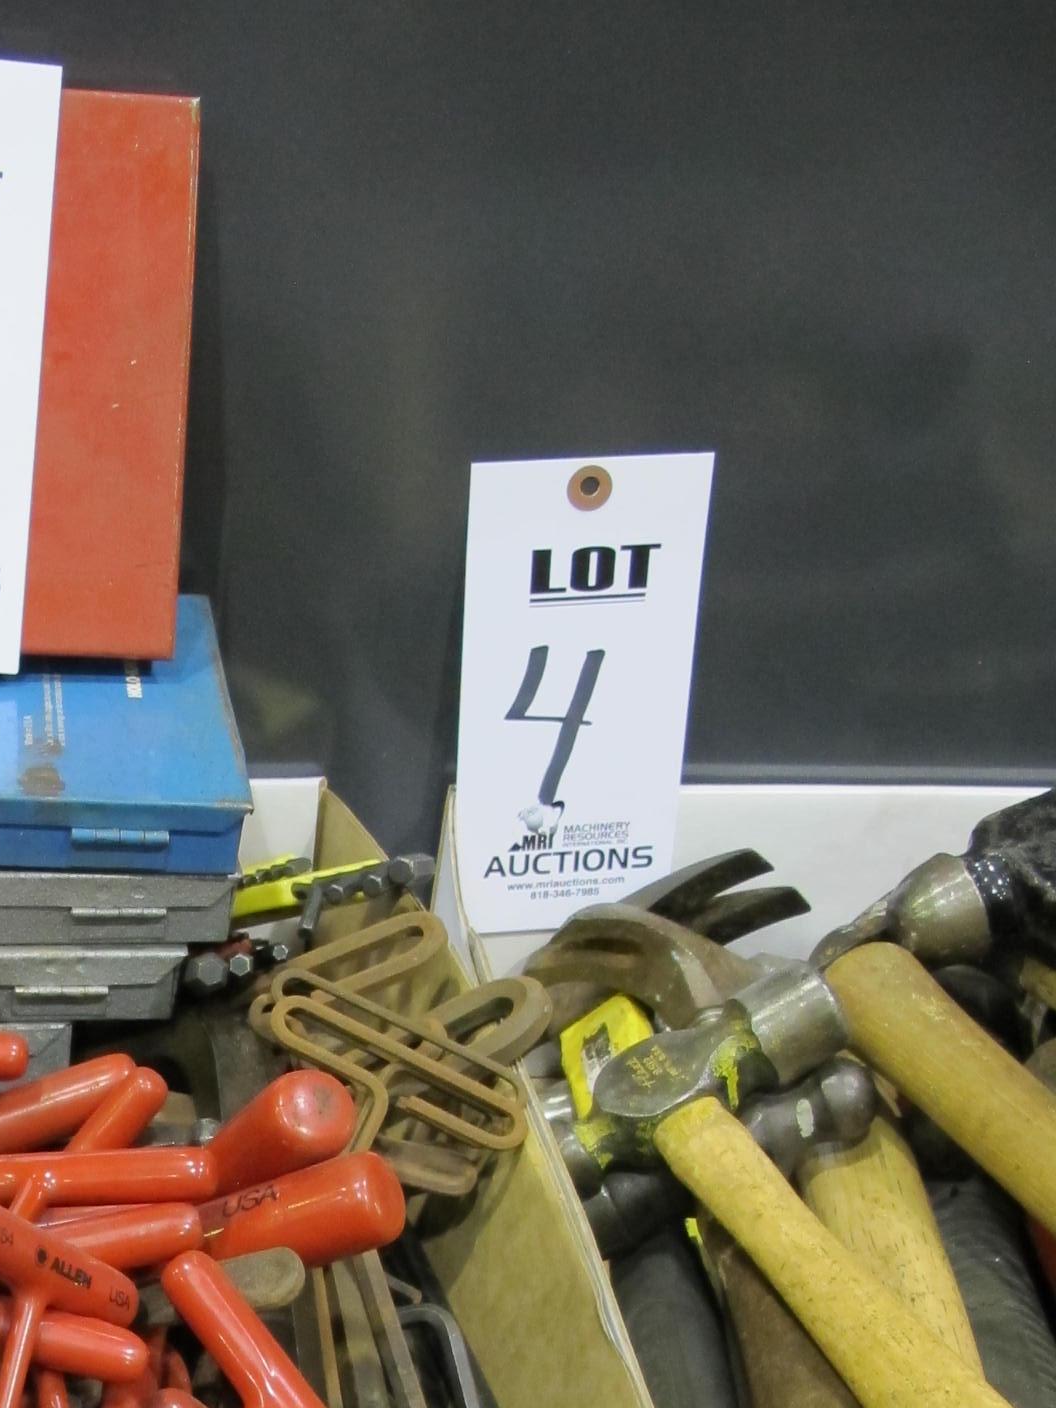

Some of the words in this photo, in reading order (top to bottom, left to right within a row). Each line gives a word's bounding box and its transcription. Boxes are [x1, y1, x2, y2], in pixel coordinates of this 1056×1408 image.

[530, 543, 662, 595] LOT
[504, 645, 605, 805] 4
[563, 821, 630, 833] MACHINERY
[563, 830, 629, 842] RESOURCES
[522, 832, 555, 851] MRI
[484, 845, 654, 879] AUCTIONS
[507, 875, 625, 891] www.mriauctions.com
[530, 887, 600, 900] 818-346-7985
[223, 1184, 278, 1217] USA
[50, 1257, 92, 1290] ALLEN
[108, 1287, 131, 1310] USA
